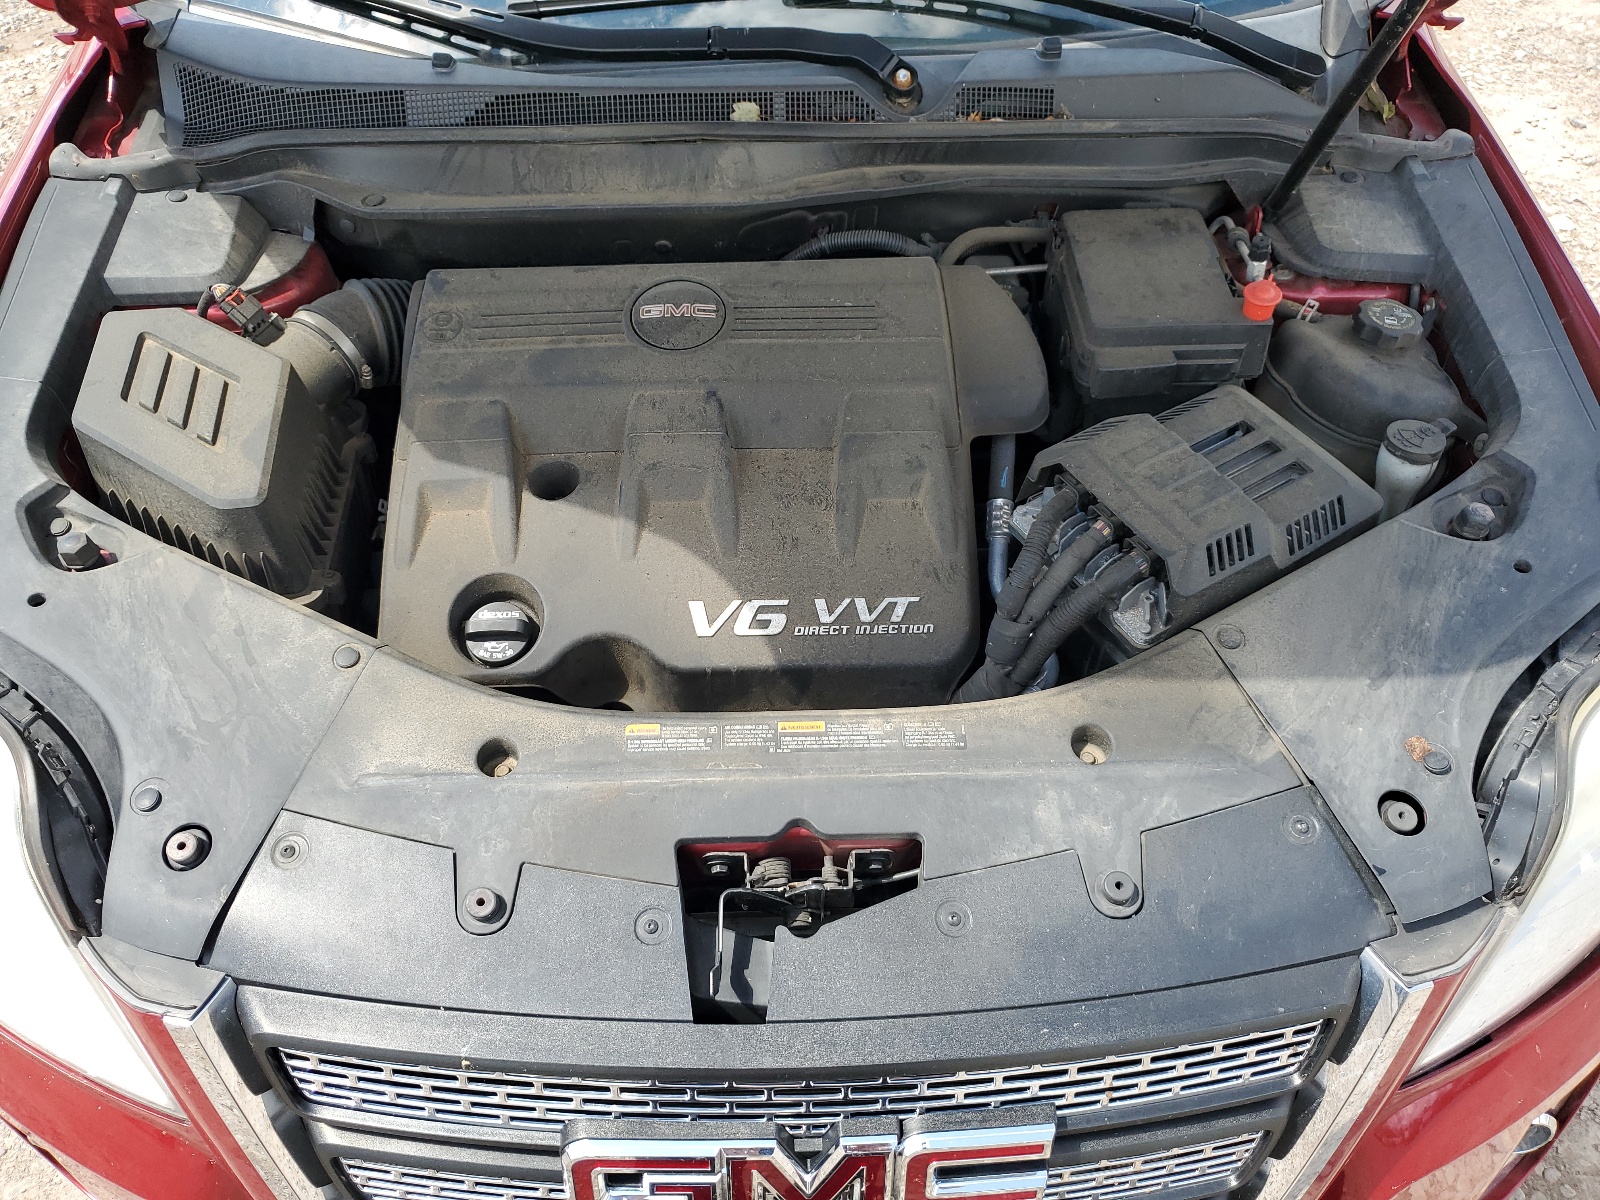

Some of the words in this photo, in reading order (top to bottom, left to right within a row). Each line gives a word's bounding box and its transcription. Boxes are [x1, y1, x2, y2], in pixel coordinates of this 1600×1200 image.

[639, 303, 717, 319] GMC
[478, 609, 522, 619] dexos
[687, 599, 790, 637] V6
[814, 597, 921, 624] VVT
[794, 624, 852, 636] DIRECT
[855, 623, 934, 635] INJECTION
[563, 1114, 1056, 1200] GMC
